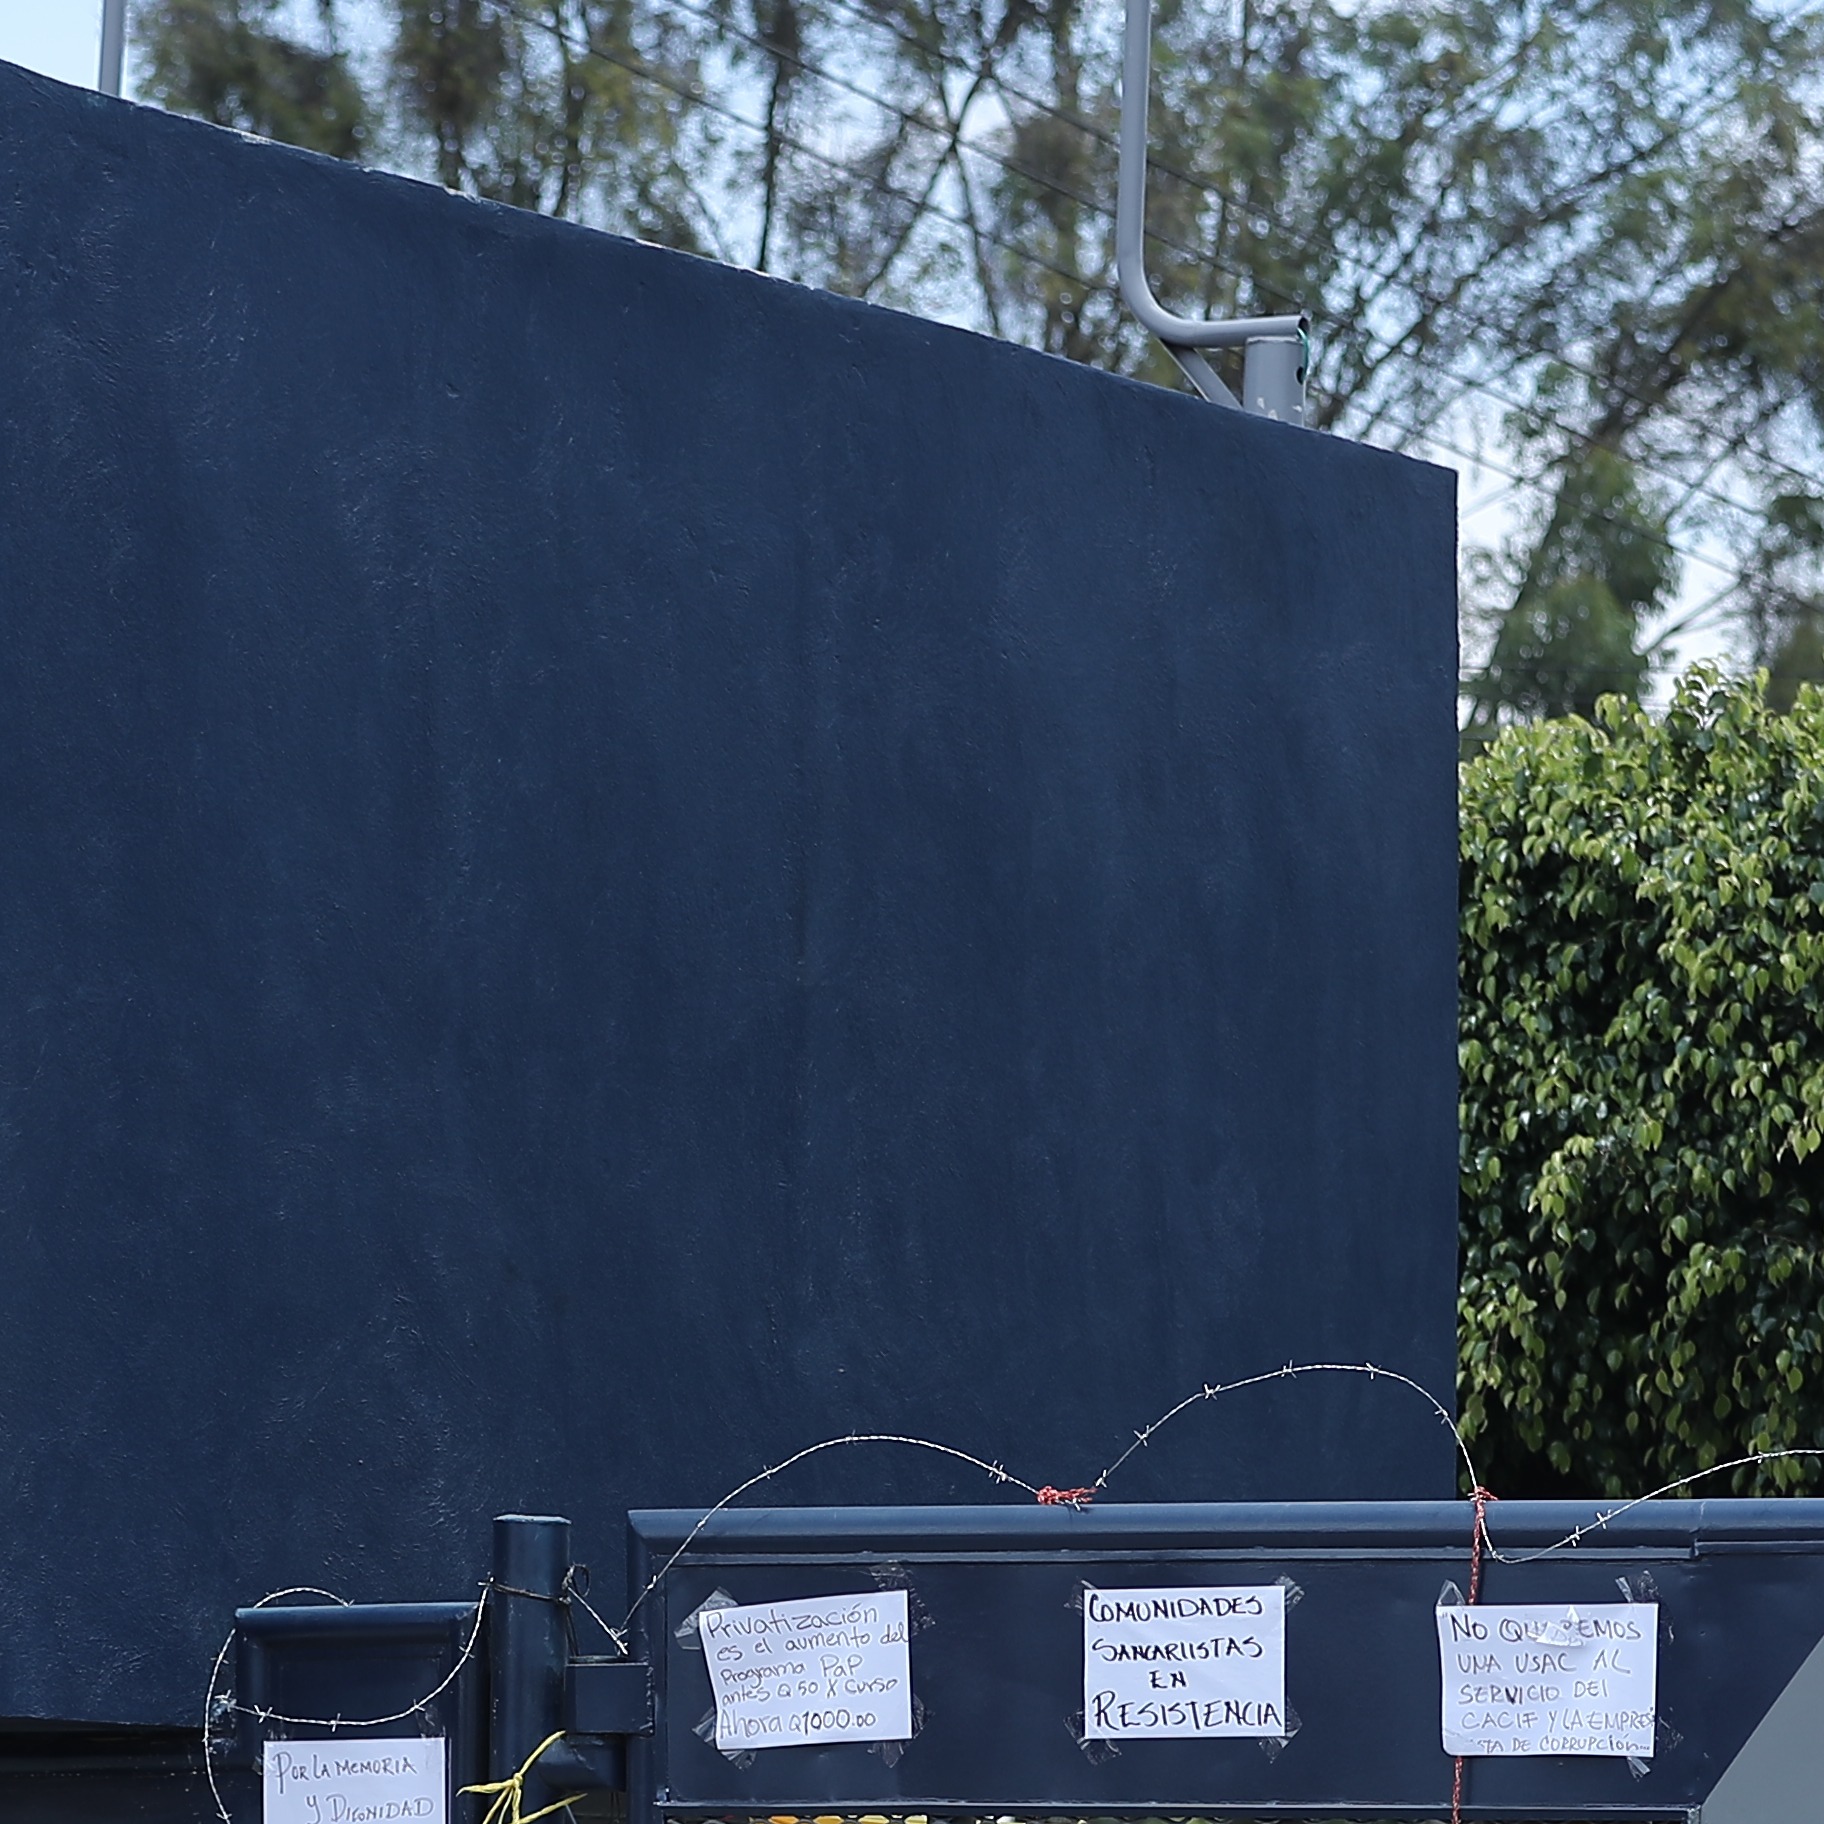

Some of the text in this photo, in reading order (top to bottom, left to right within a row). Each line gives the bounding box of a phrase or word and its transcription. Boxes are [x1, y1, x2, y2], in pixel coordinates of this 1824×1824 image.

[1089, 1594, 1263, 1622] COMUNIDADES
[706, 1603, 878, 1639] Privatización
[717, 1622, 909, 1661] es el aumento del
[1458, 1649, 1631, 1674] UNA USAC AL
[1149, 1671, 1187, 1688] EN
[722, 1685, 770, 1706] antes
[1459, 1684, 1560, 1705] SERVICIO
[1092, 1691, 1282, 1730] RESISTENCIA
[1462, 1711, 1538, 1730] CACIF
[1549, 1711, 1557, 1733] Y
[1563, 1708, 1583, 1730] LA
[719, 1709, 782, 1739] Ahora
[1513, 1738, 1531, 1752] DE
[334, 1756, 418, 1776] MEMORIA
